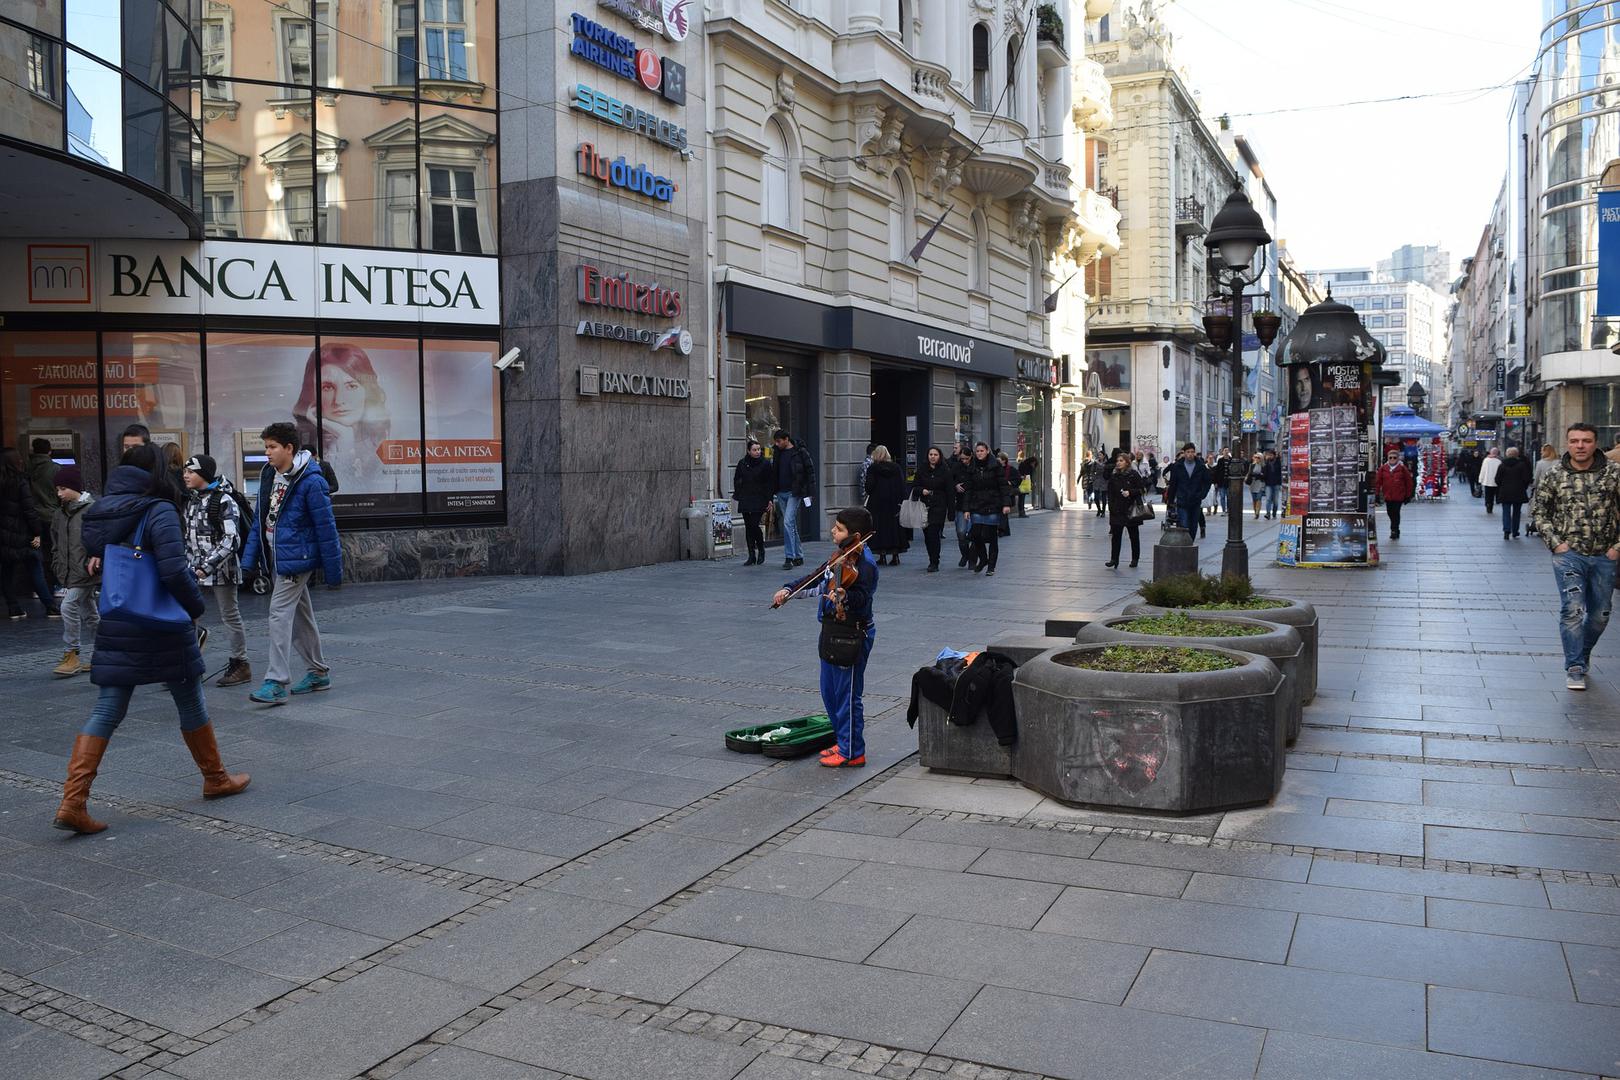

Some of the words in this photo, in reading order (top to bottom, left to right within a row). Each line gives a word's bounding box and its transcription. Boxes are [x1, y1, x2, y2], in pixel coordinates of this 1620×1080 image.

[570, 12, 636, 59] TURKISH
[571, 37, 637, 80] AIRLINES
[109, 253, 298, 301] BANCA
[321, 262, 486, 310] INTESA
[579, 264, 682, 317] Emirates
[128, 364, 137, 379] U
[602, 370, 650, 396] BANCA
[653, 376, 693, 398] INTESA
[1327, 365, 1360, 376] MOSTAR
[1497, 359, 1505, 391] HOTEL
[39, 394, 68, 410] SVET
[406, 446, 451, 458] BANCA
[454, 445, 493, 457] INTESA
[1306, 518, 1330, 527] CHRIS
